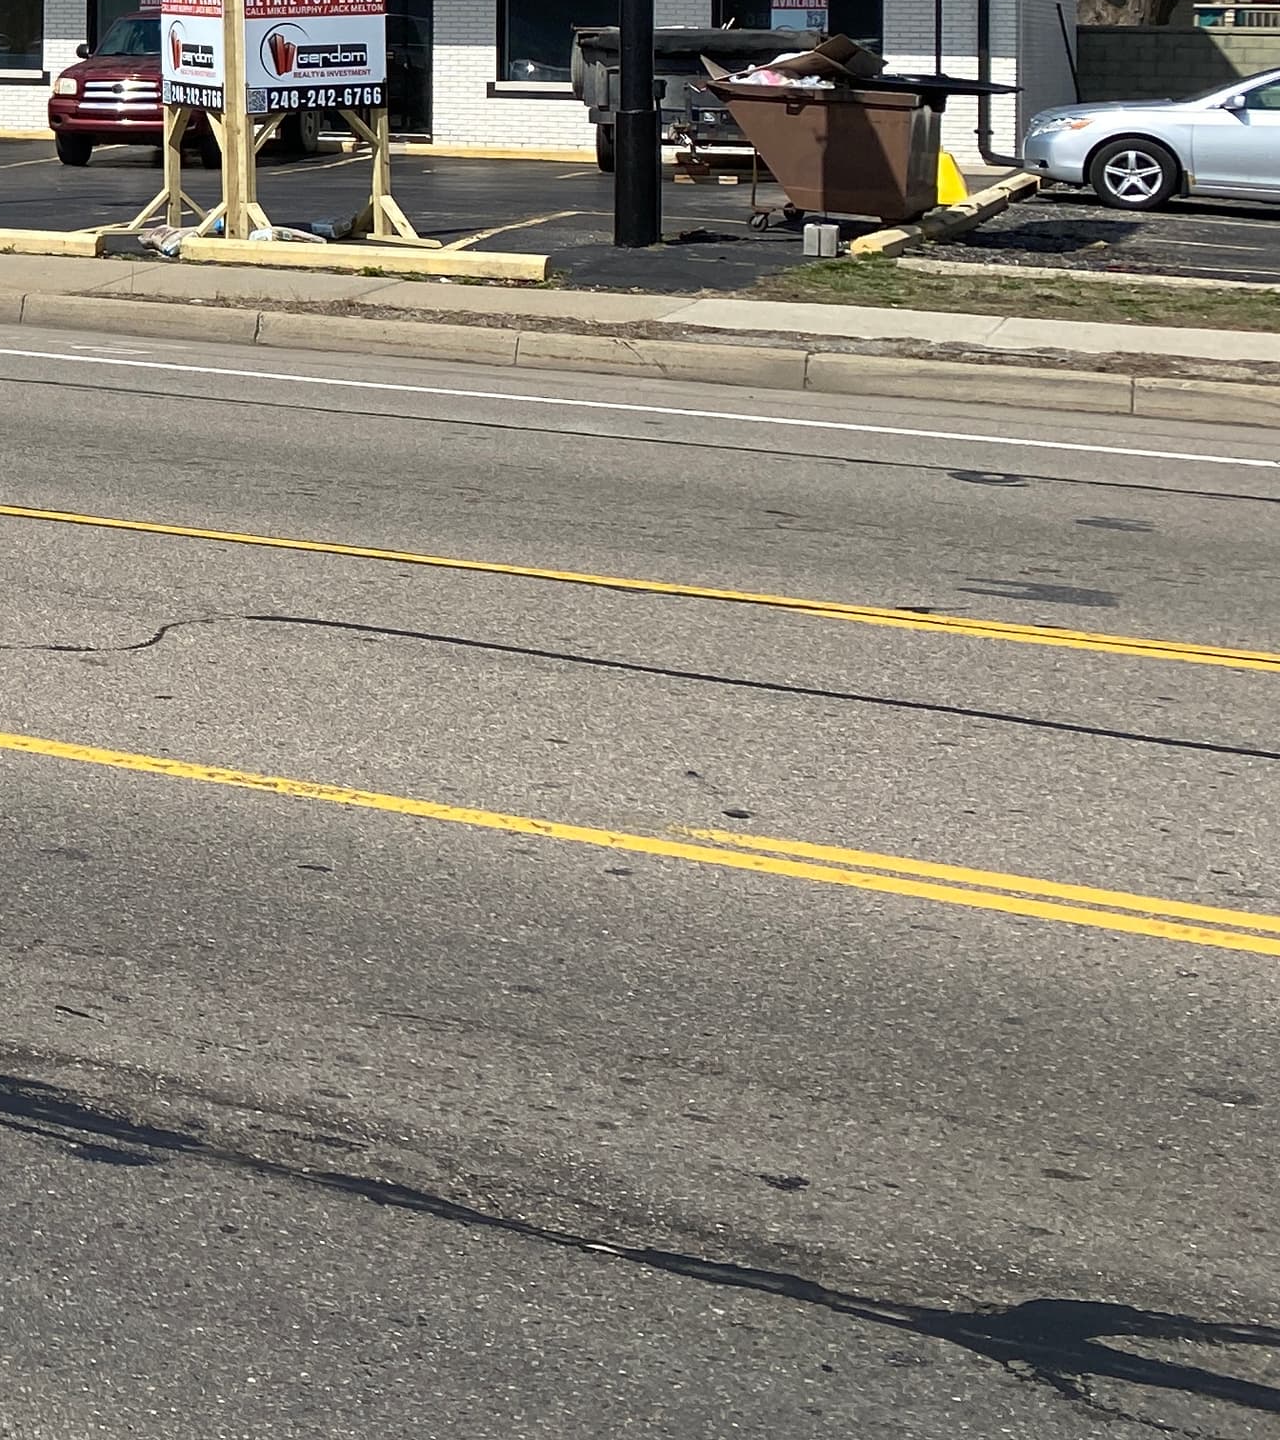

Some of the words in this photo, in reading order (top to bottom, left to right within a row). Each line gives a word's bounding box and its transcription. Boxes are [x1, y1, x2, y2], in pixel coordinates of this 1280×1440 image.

[245, 7, 266, 16] CALL
[267, 6, 287, 15] MIKE
[288, 5, 323, 15] MURPHY
[329, 4, 350, 13] JACK
[351, 3, 384, 13] MELTON
[293, 71, 320, 79] REALTY
[326, 68, 372, 78] INVESTMENT
[270, 87, 382, 109] 248-242-6766
